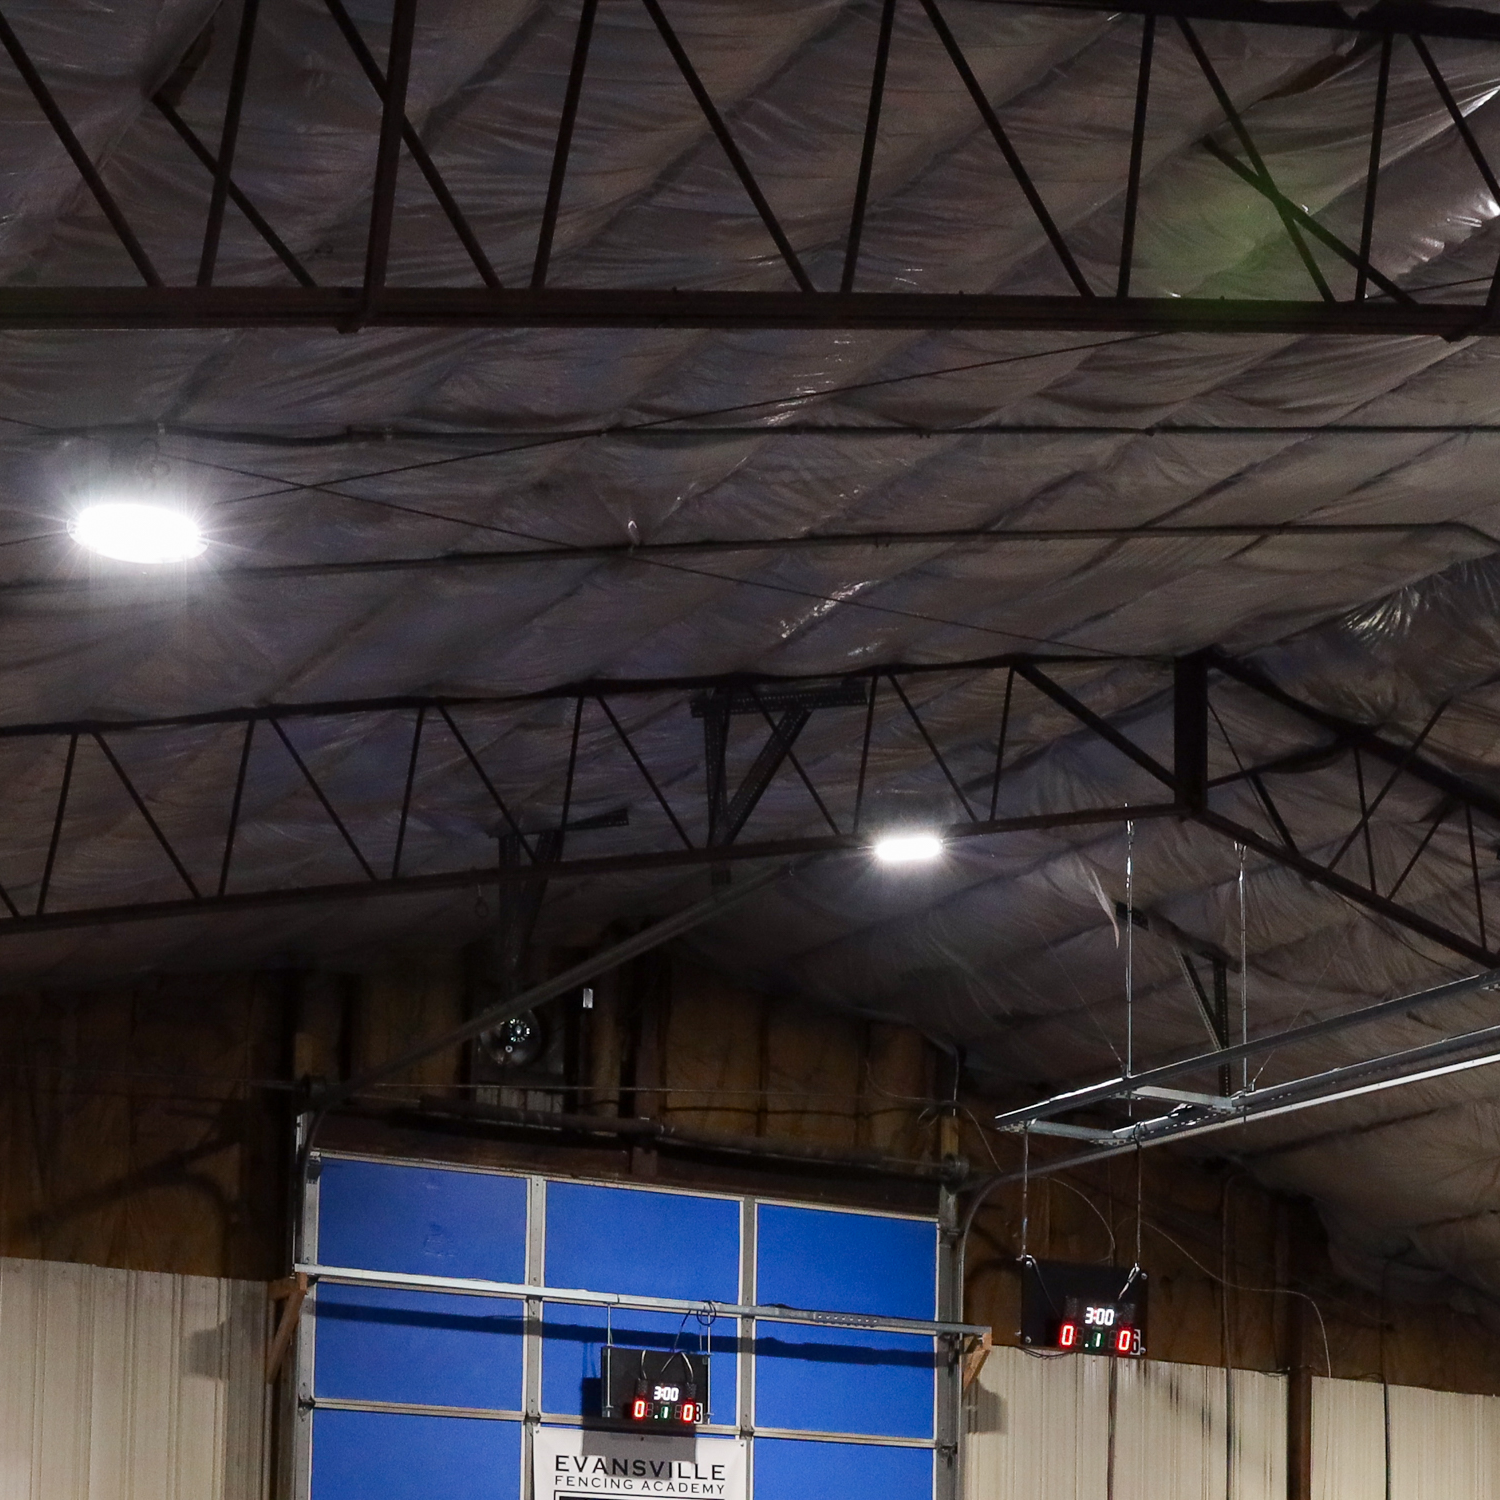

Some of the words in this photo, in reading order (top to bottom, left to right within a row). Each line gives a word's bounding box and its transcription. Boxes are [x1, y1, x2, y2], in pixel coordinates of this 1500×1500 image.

[1084, 1306, 1115, 1326] 3:00
[1061, 1325, 1074, 1346] 0
[1118, 1330, 1131, 1351] 0
[653, 1385, 680, 1402] 3:00
[634, 1400, 646, 1418] 0
[682, 1403, 694, 1421] 0
[555, 1455, 726, 1480] EVANSVILLE
[555, 1475, 634, 1490] FENCING
[641, 1480, 725, 1495] ACADEMY
